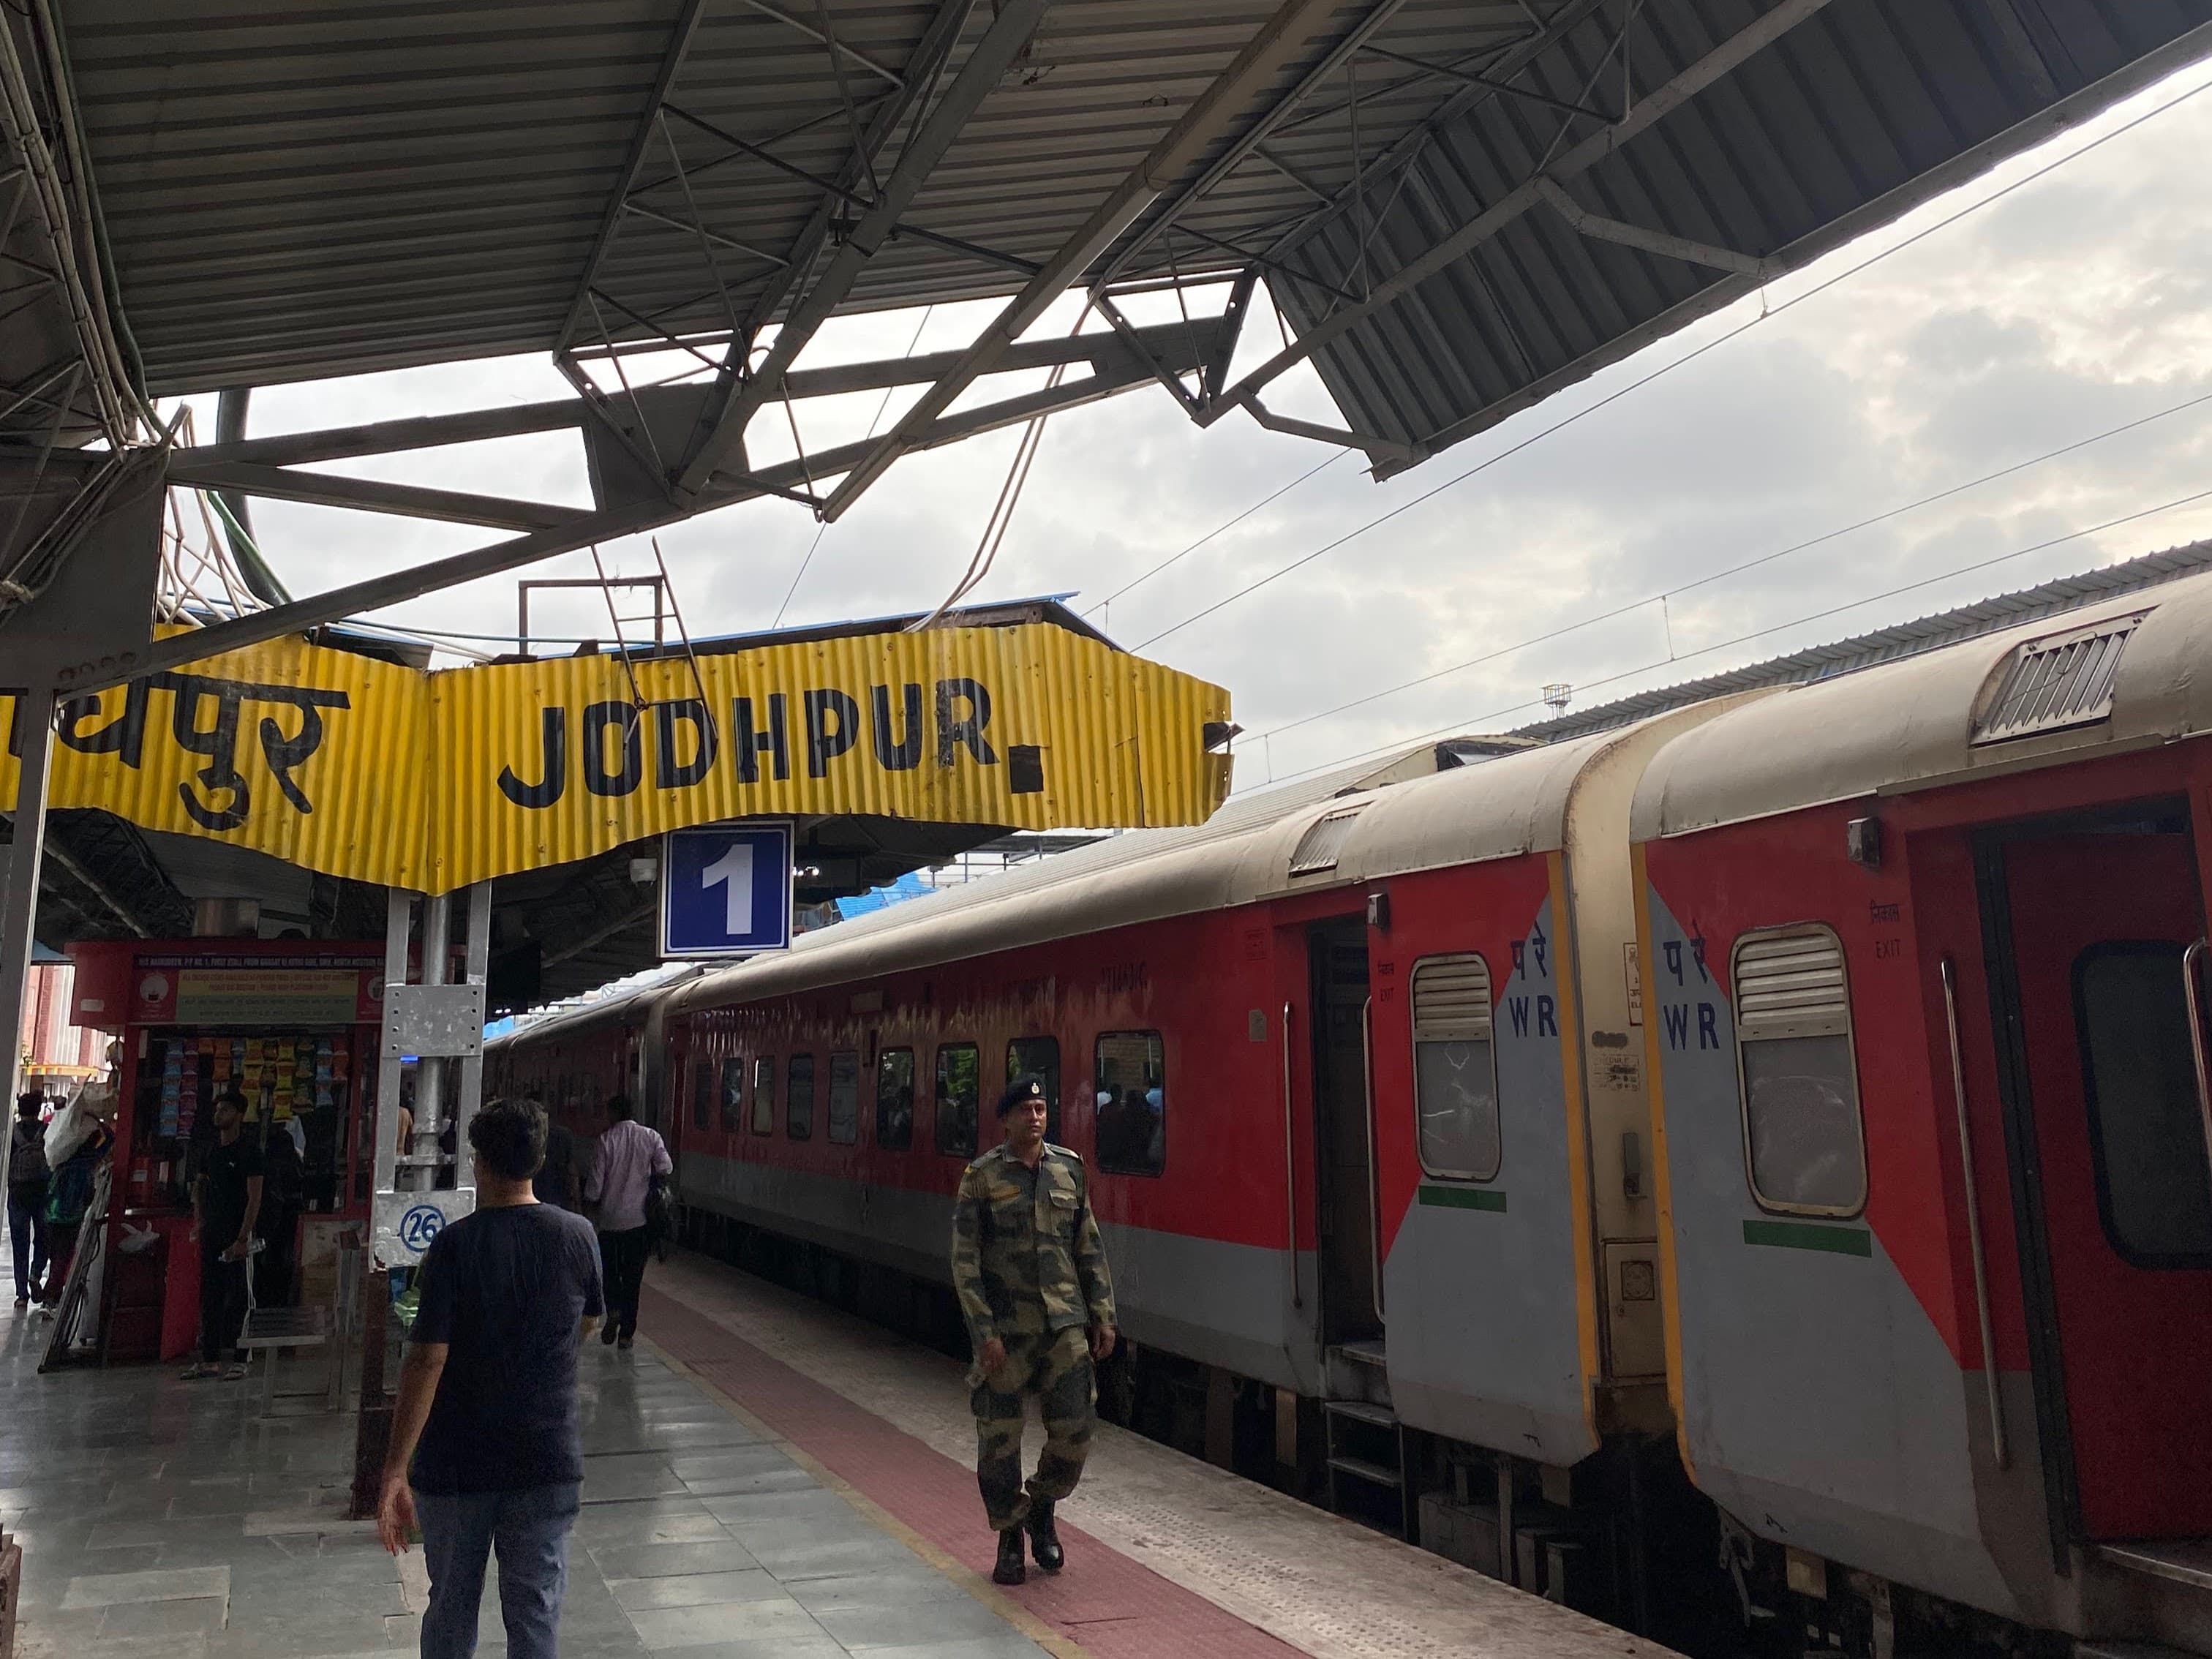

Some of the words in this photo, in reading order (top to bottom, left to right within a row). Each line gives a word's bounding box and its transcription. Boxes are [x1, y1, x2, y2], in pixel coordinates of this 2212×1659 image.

[497, 676, 1000, 809] JODHPUR
[702, 843, 753, 936] 1
[1875, 938, 1901, 959] EXIT
[1508, 995, 1558, 1038] WR
[1663, 1002, 1720, 1050] WR
[408, 1213, 438, 1242] 26
